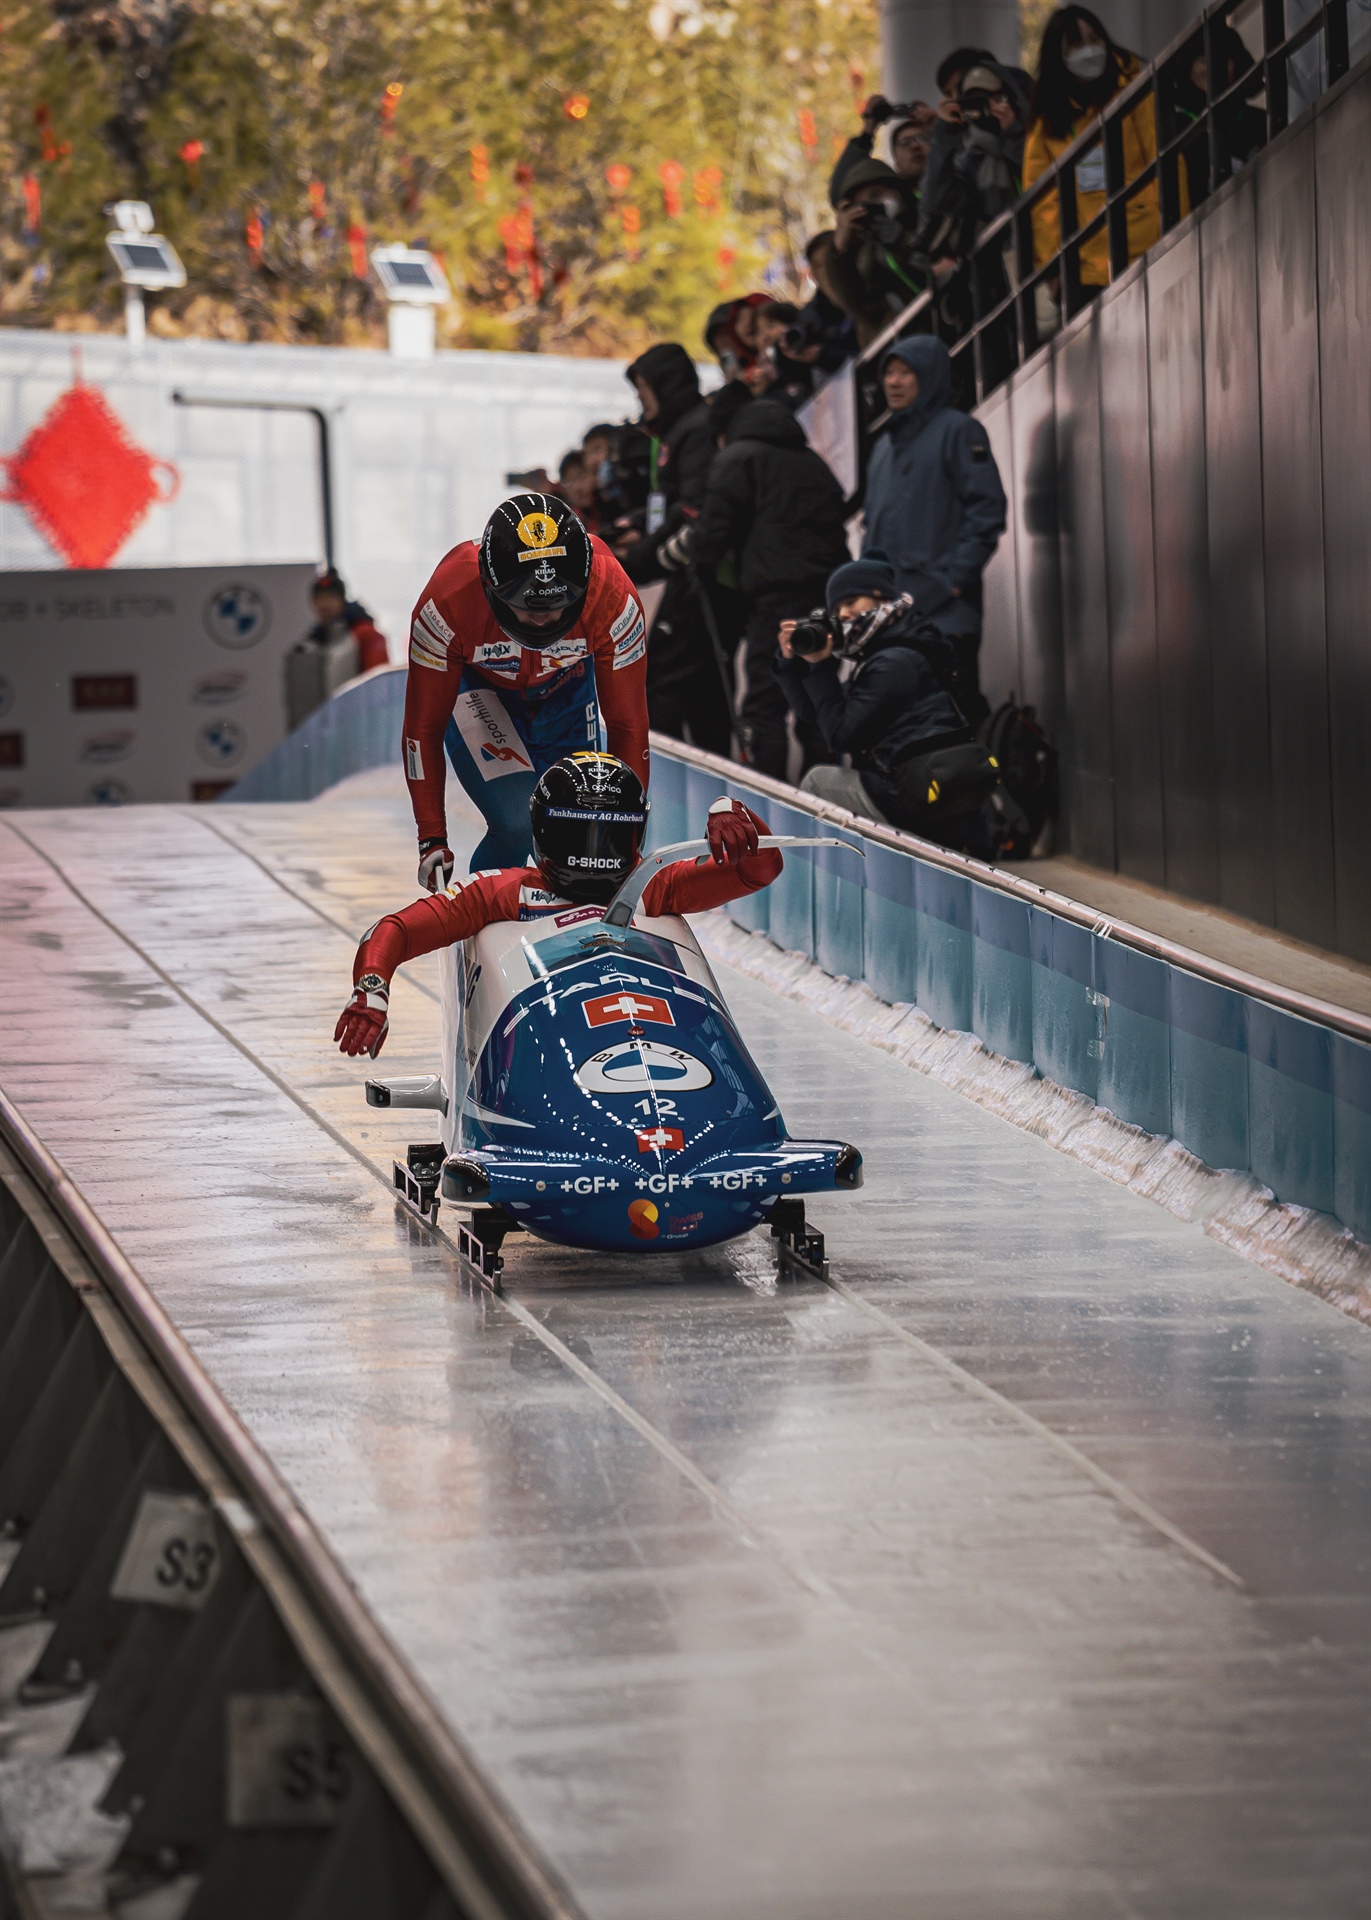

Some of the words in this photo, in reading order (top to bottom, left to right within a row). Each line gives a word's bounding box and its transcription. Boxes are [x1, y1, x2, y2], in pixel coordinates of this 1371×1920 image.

[538, 585, 568, 597] aprica
[618, 621, 643, 651] KOHLER
[466, 691, 507, 745] sporthilfe
[548, 808, 598, 820] Fankhauser
[598, 813, 612, 821] AG
[613, 814, 644, 822] Rohrbach
[567, 855, 622, 869] G-SHOCK
[591, 1042, 694, 1063] BMW
[634, 1098, 679, 1116] 12
[156, 1537, 216, 1592] S3
